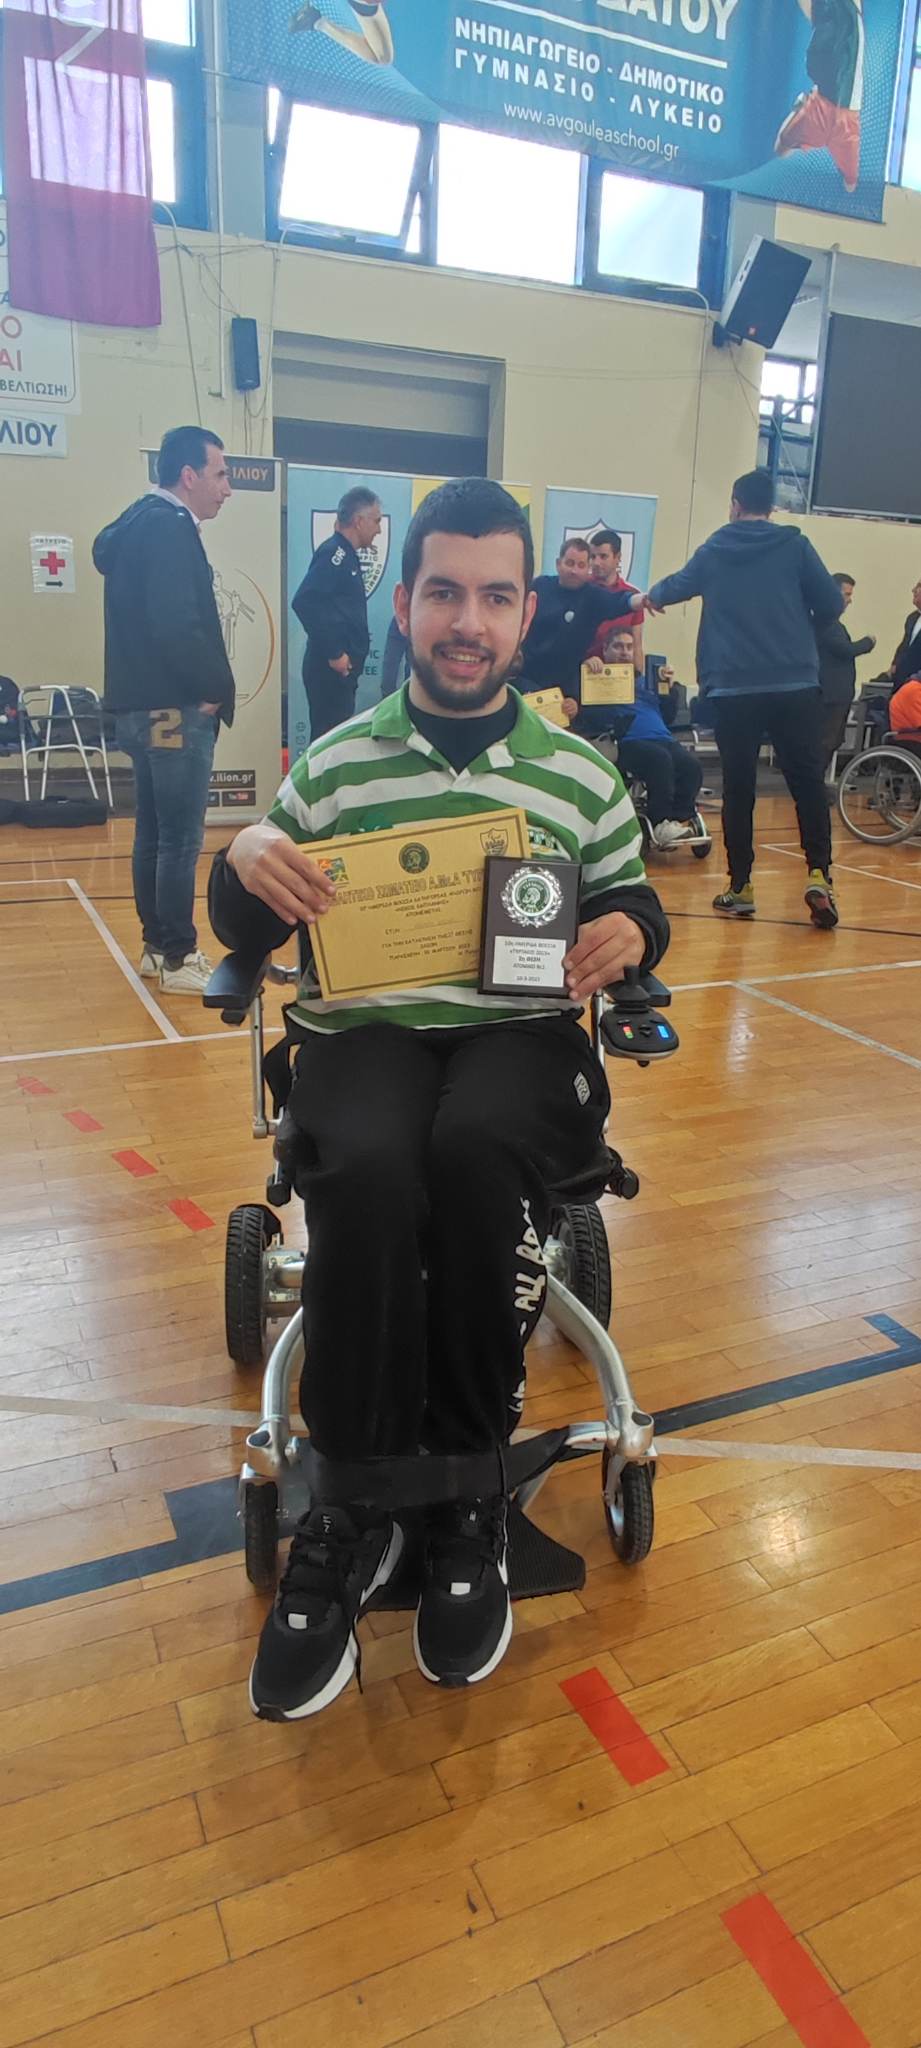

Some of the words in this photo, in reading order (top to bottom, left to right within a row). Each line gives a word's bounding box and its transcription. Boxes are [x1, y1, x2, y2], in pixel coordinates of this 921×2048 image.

[455, 17, 600, 74] ΝΗΠΙΑΓΩΓΕΙΟ
[619, 62, 724, 105] ΔΗΜΟΤΙΚΟ
[455, 48, 594, 102] ΓΥΜΝΑΣΙΟ
[629, 94, 722, 133] ΛΥΚΕΙΟ
[504, 103, 679, 161] www.avgouleaschool.gr
[149, 708, 183, 748] 2
